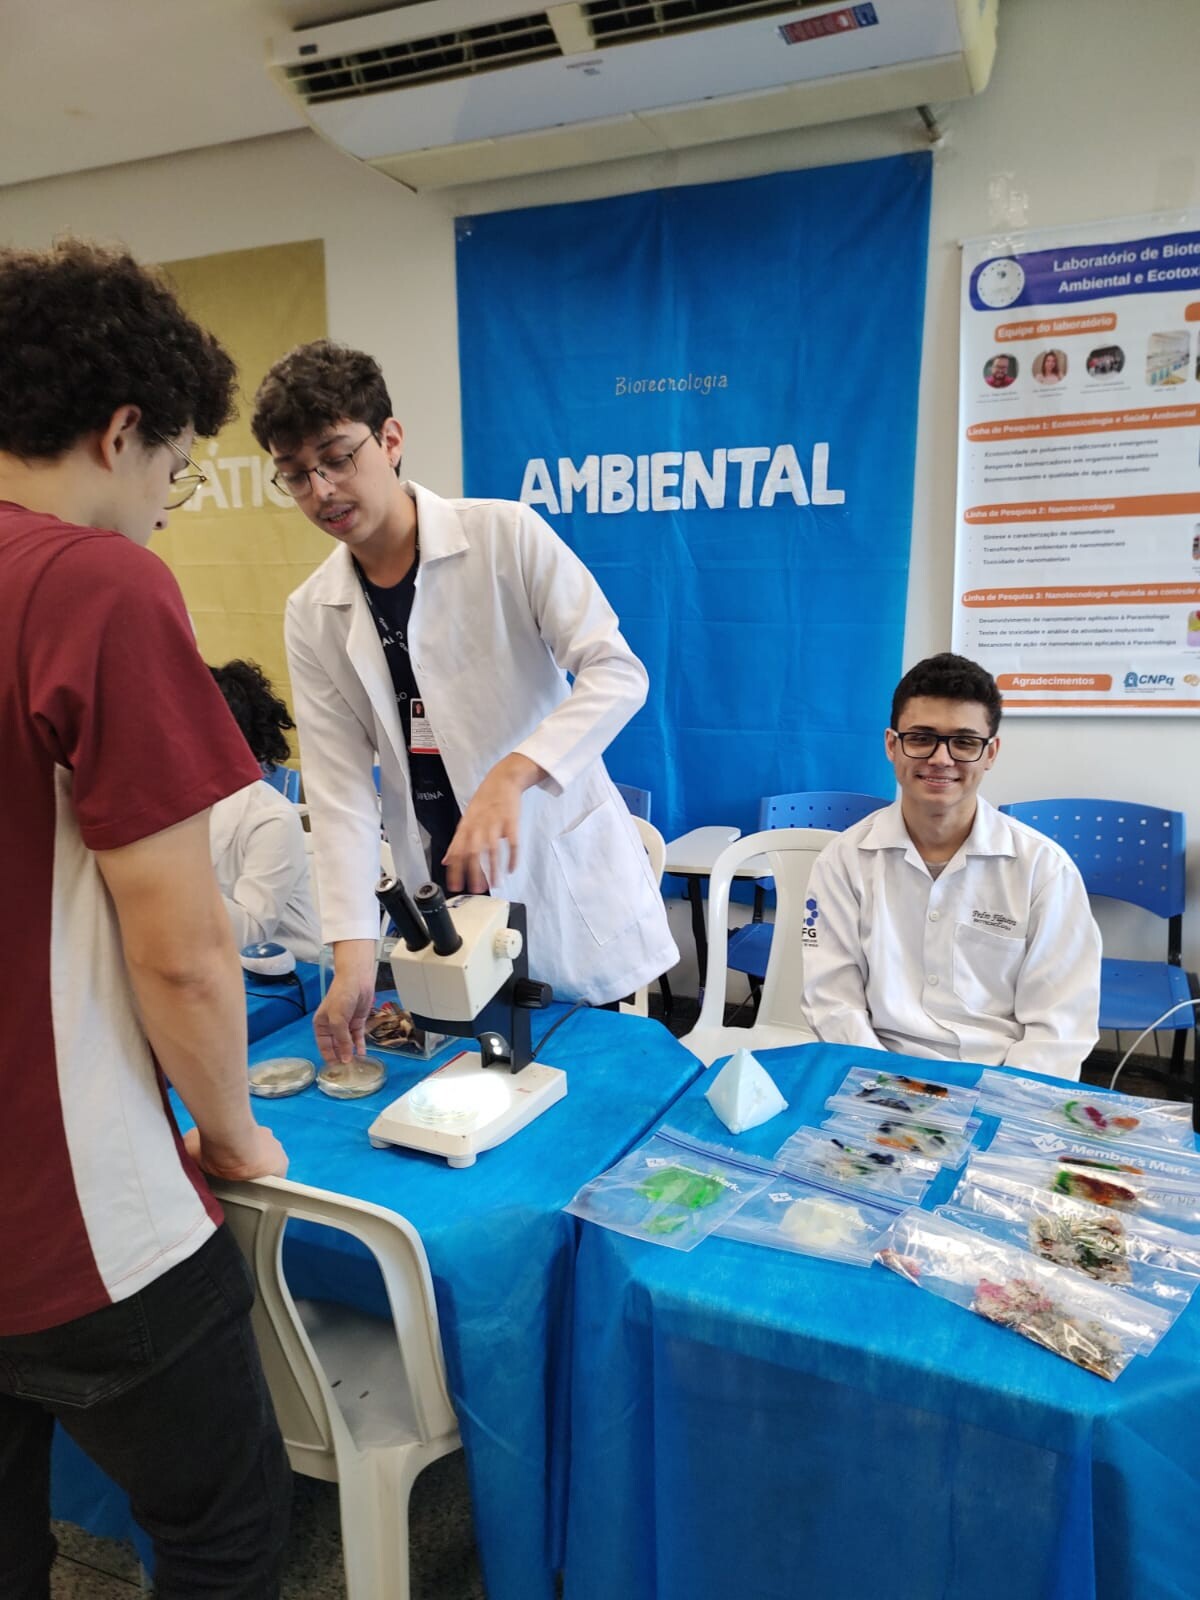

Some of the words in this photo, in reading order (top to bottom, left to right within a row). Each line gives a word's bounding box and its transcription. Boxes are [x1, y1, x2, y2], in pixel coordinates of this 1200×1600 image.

[1053, 250, 1137, 272] Laboratório
[1140, 246, 1159, 261] de
[1058, 273, 1131, 293] Ambiental
[1134, 273, 1143, 284] e
[998, 325, 1033, 339] Equipe
[1037, 323, 1051, 333] do
[1053, 316, 1113, 331] laboratório
[615, 373, 729, 396] Biotecnologia
[519, 442, 845, 515] AMBIENTAL
[963, 593, 985, 602] Linha
[1012, 676, 1095, 688] Agradecimentos
[1138, 674, 1175, 687] CNPq
[1070, 1143, 1146, 1169] Member's
[1149, 1159, 1193, 1176] Mark
